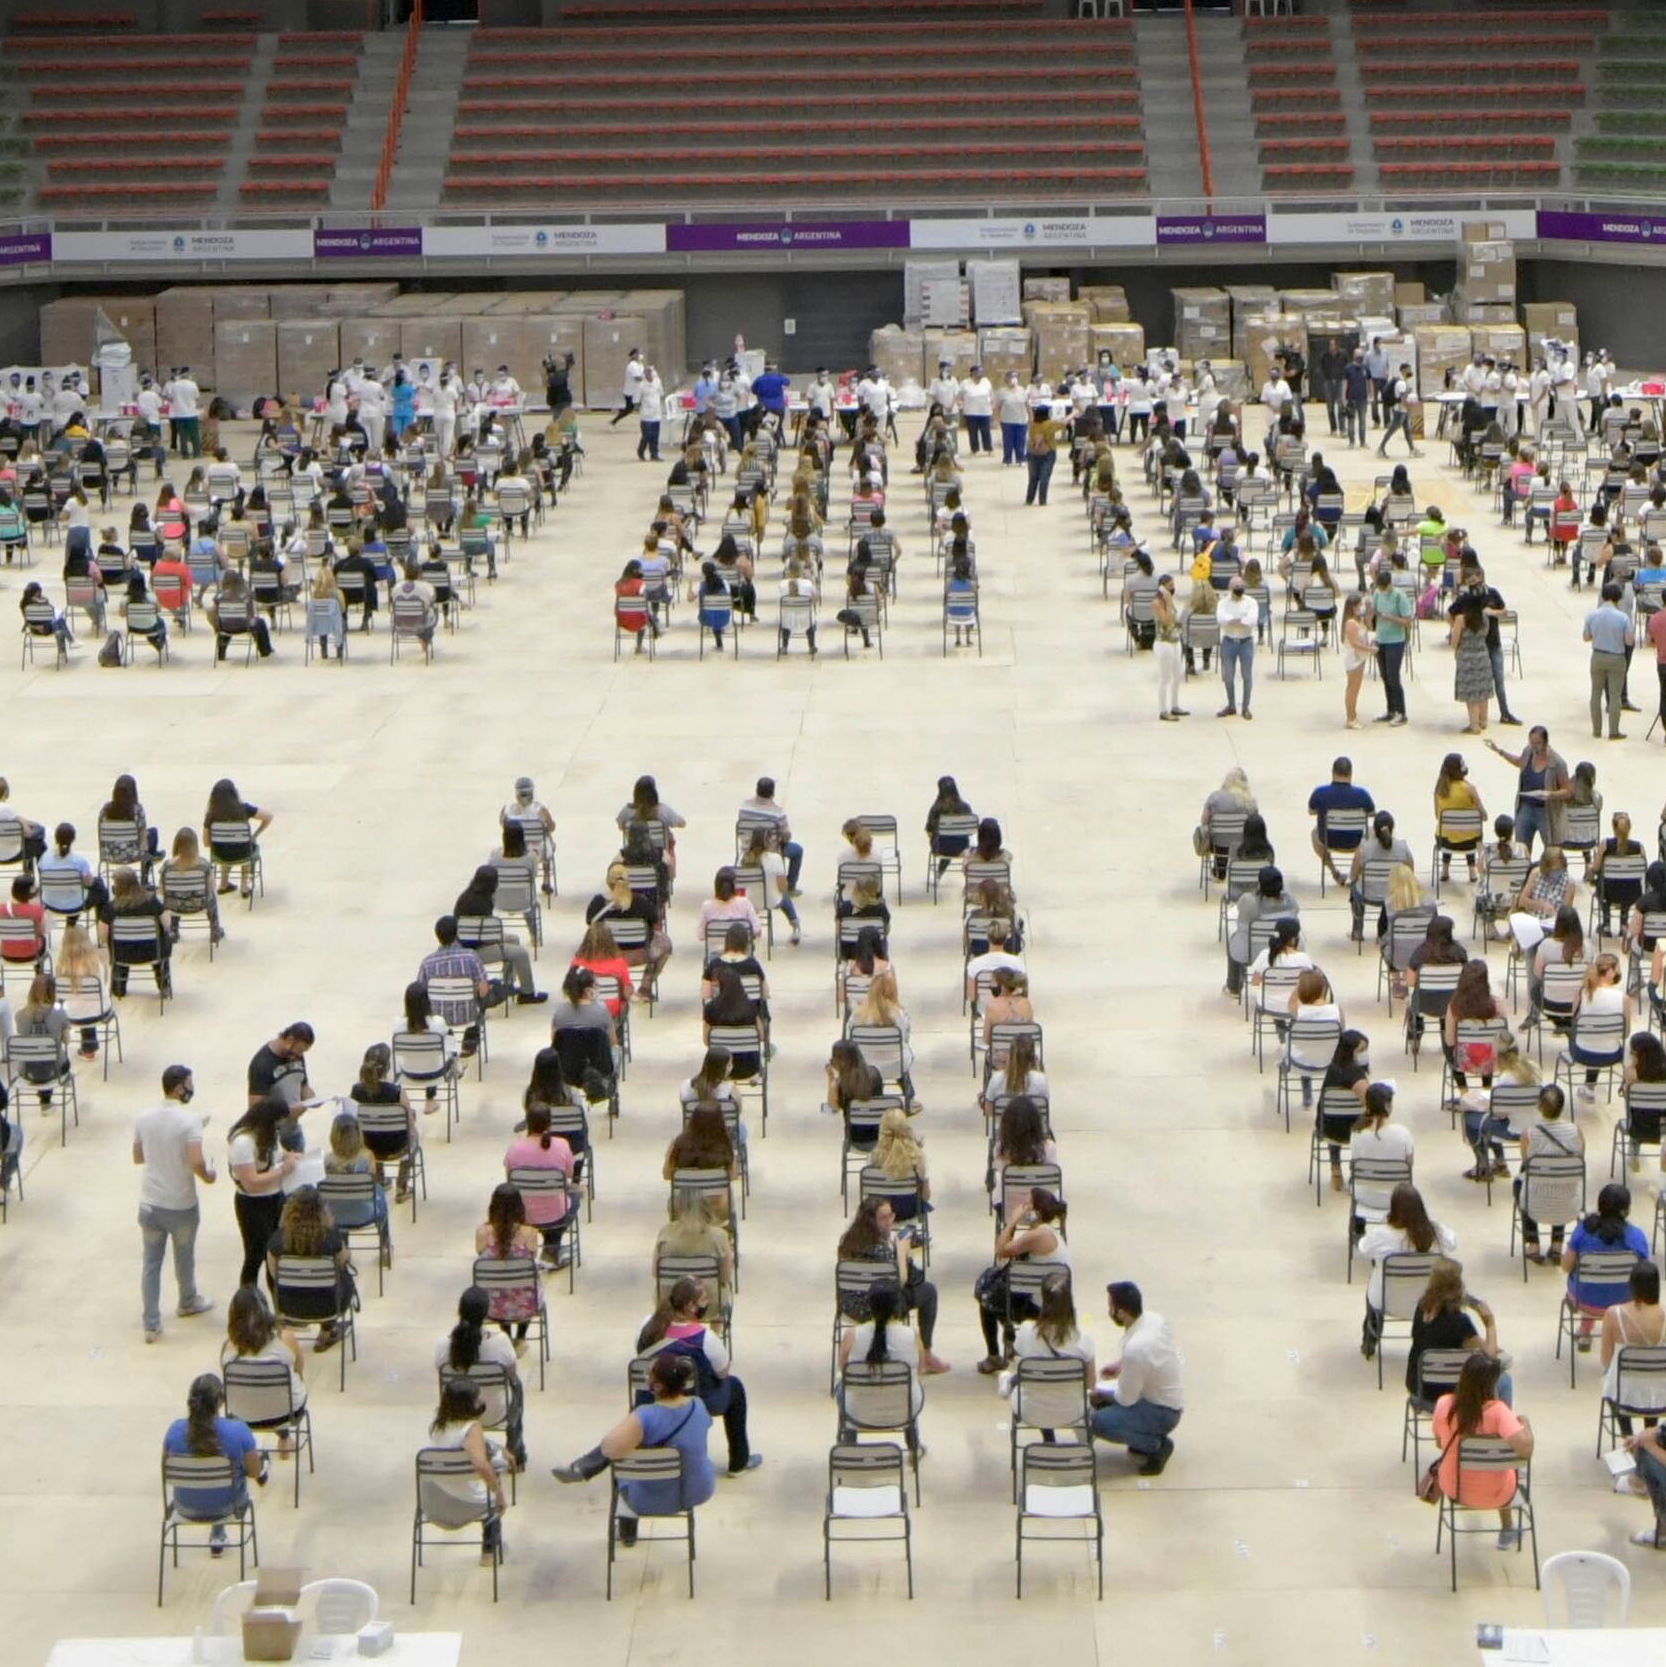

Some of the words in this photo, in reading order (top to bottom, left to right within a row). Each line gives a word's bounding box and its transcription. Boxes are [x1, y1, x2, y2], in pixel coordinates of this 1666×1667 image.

[1042, 223, 1087, 232] MENDOZA
[1410, 218, 1455, 227] MENDOZA
[1158, 225, 1202, 235] MENDOZA
[1215, 224, 1264, 235] ARGENTINA
[1602, 223, 1640, 234] MENDOZA
[191, 236, 234, 245] MENDOZA
[554, 232, 598, 240] MENDOZA
[736, 232, 780, 242] MENDOZA
[793, 231, 842, 241] ARGENTINA
[316, 237, 358, 248] MENDOZA
[372, 236, 421, 247] ARGENTINA
